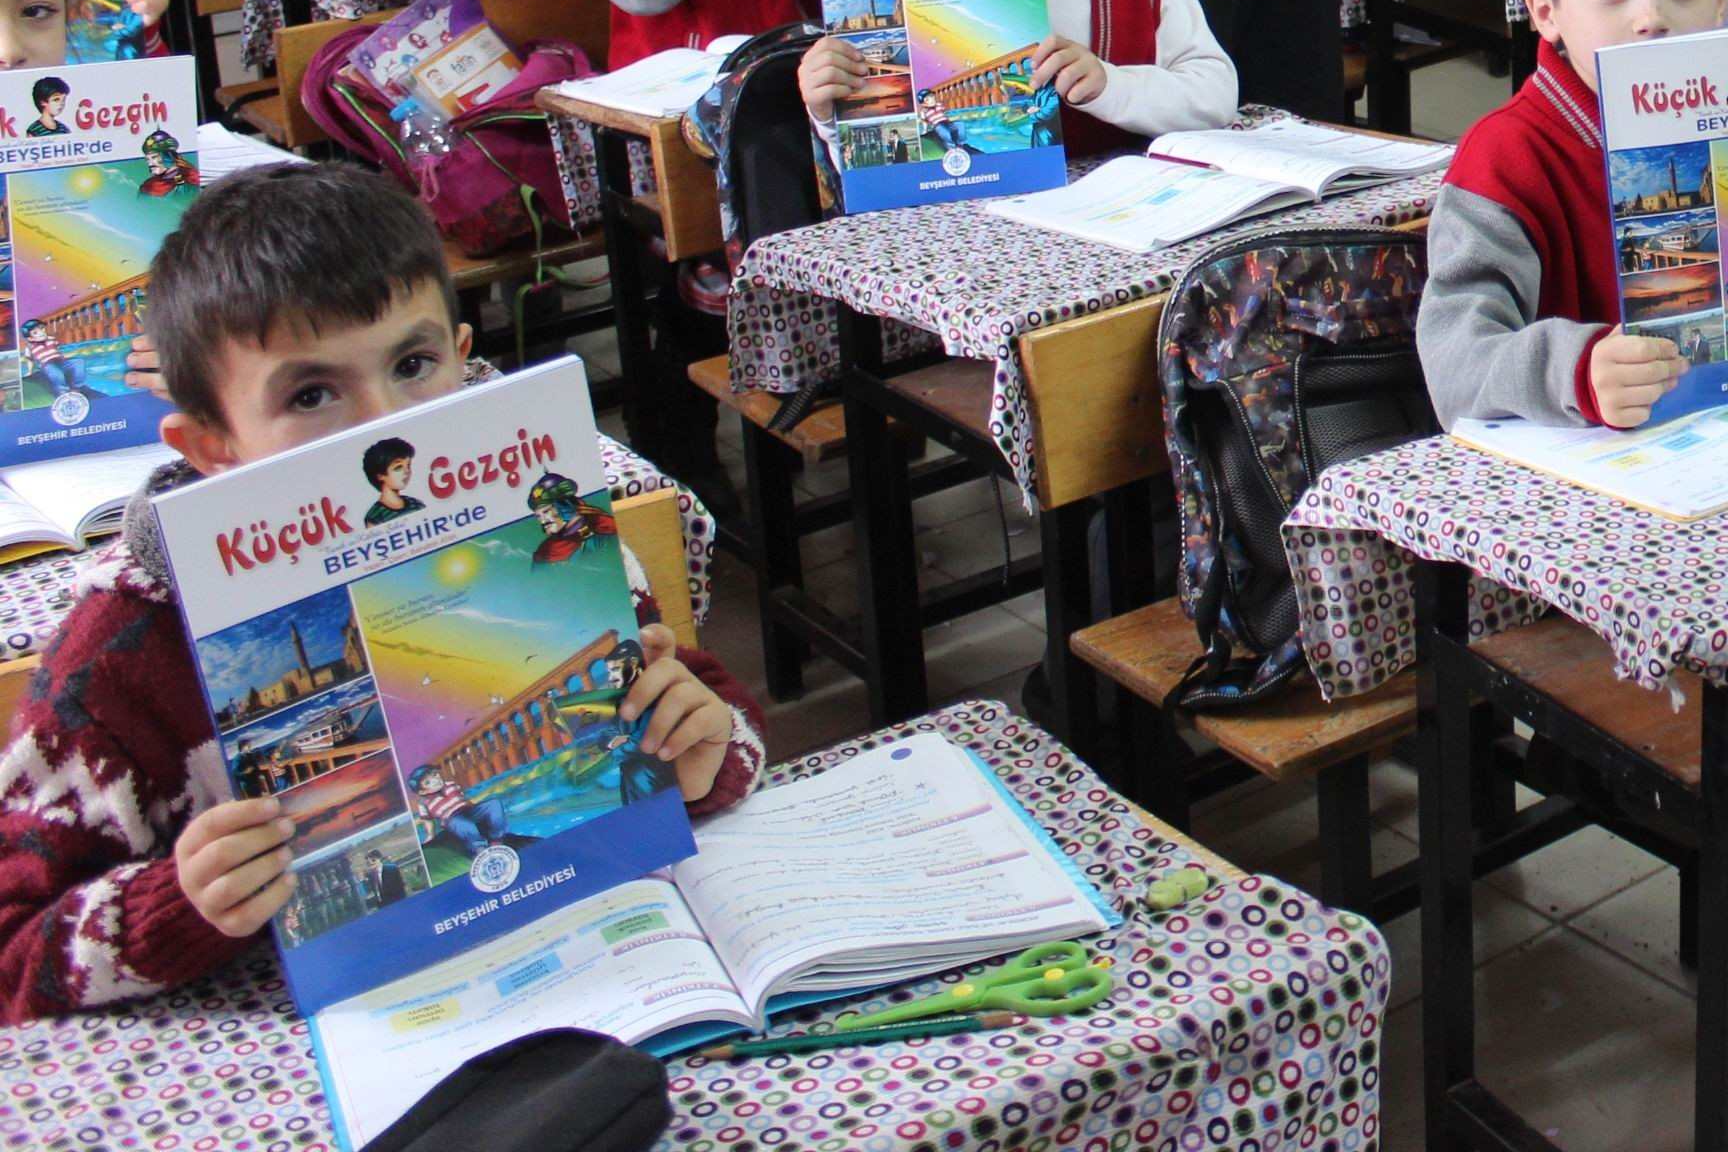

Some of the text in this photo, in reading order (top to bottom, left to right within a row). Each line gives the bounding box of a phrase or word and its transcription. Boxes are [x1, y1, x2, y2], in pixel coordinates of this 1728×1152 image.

[75, 92, 168, 135] Gezgin
[1631, 75, 1718, 119] Küçük
[216, 427, 557, 577] Küçük Gezgin
[324, 504, 488, 576] BEYŞEHİR'de
[434, 863, 577, 936] BEYŞEHİR BELEDİYESİ
